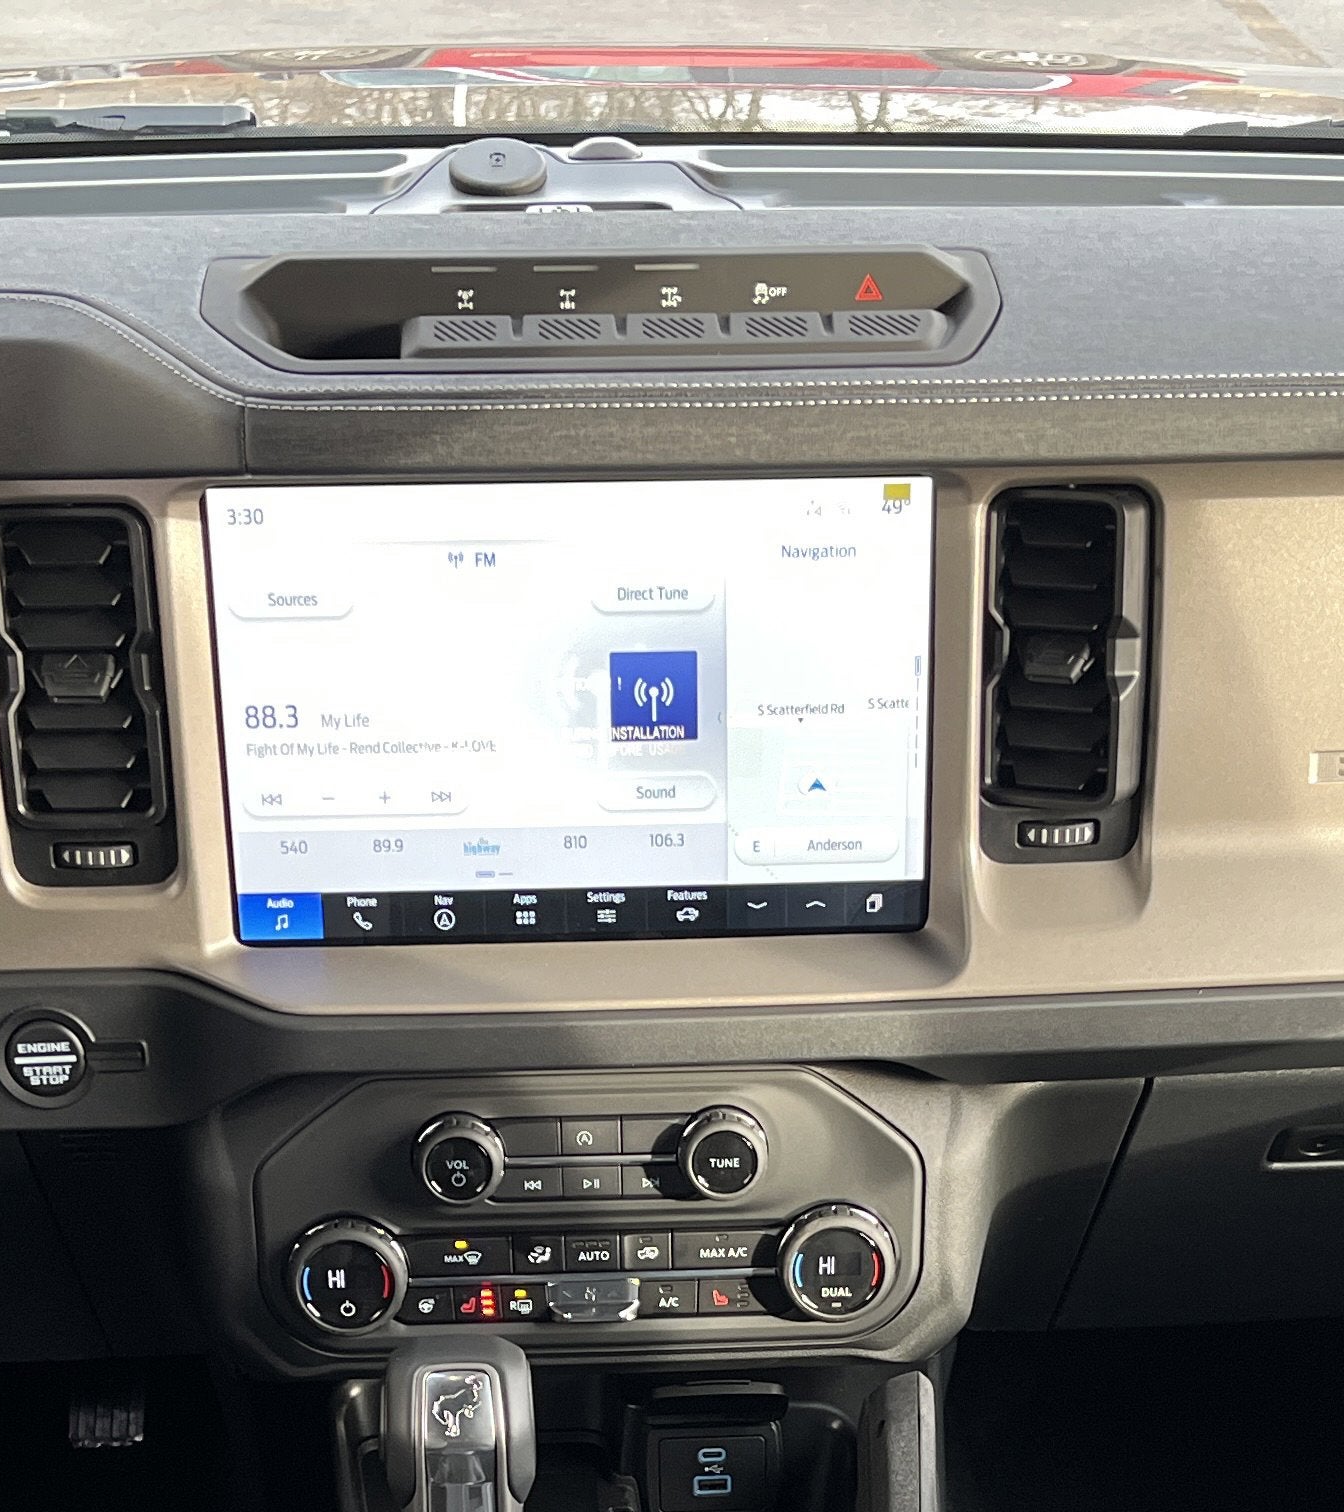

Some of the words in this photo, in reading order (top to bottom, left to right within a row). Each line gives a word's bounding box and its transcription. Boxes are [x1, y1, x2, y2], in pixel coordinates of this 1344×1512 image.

[768, 286, 787, 297] OFF
[227, 508, 264, 525] 3:30
[781, 545, 856, 561] Navigation
[475, 552, 496, 568] FM
[268, 592, 318, 607] Sources
[617, 587, 654, 601] Direct
[656, 586, 689, 600] Tune
[757, 705, 765, 716] S
[767, 703, 829, 716] Scatterfield
[831, 704, 845, 714] Rd
[868, 699, 875, 709] S
[245, 705, 299, 729] 88.3
[321, 714, 341, 731] My
[344, 713, 370, 728] Life
[247, 742, 278, 758] Fight
[281, 742, 295, 755] Of
[297, 743, 316, 758] My
[318, 741, 340, 755] Life
[349, 741, 381, 755] Rend
[636, 785, 676, 801] Sound
[280, 840, 308, 854] 540
[373, 838, 404, 853] 89.9
[563, 835, 587, 849] 810
[648, 833, 685, 848] 106.3
[752, 840, 761, 853] E
[807, 839, 863, 852] Anderson
[346, 896, 378, 907] Phone
[434, 895, 454, 906] Nav
[513, 893, 537, 907] Apps
[587, 891, 626, 904] Settings
[667, 889, 708, 902] Features
[266, 898, 295, 909] Audio
[17, 1041, 71, 1054] ENGINE
[22, 1065, 72, 1077] START
[29, 1075, 69, 1086] STOP
[446, 1159, 470, 1170] VOL
[709, 1157, 740, 1169] TUNE
[444, 1254, 464, 1263] MAX
[578, 1251, 610, 1261] AUTO
[699, 1248, 726, 1259] MAX
[727, 1247, 748, 1258] A/C
[818, 1256, 835, 1275] HI
[327, 1269, 346, 1289] HI
[821, 1287, 852, 1298] DUAL
[659, 1296, 679, 1308] A/C
